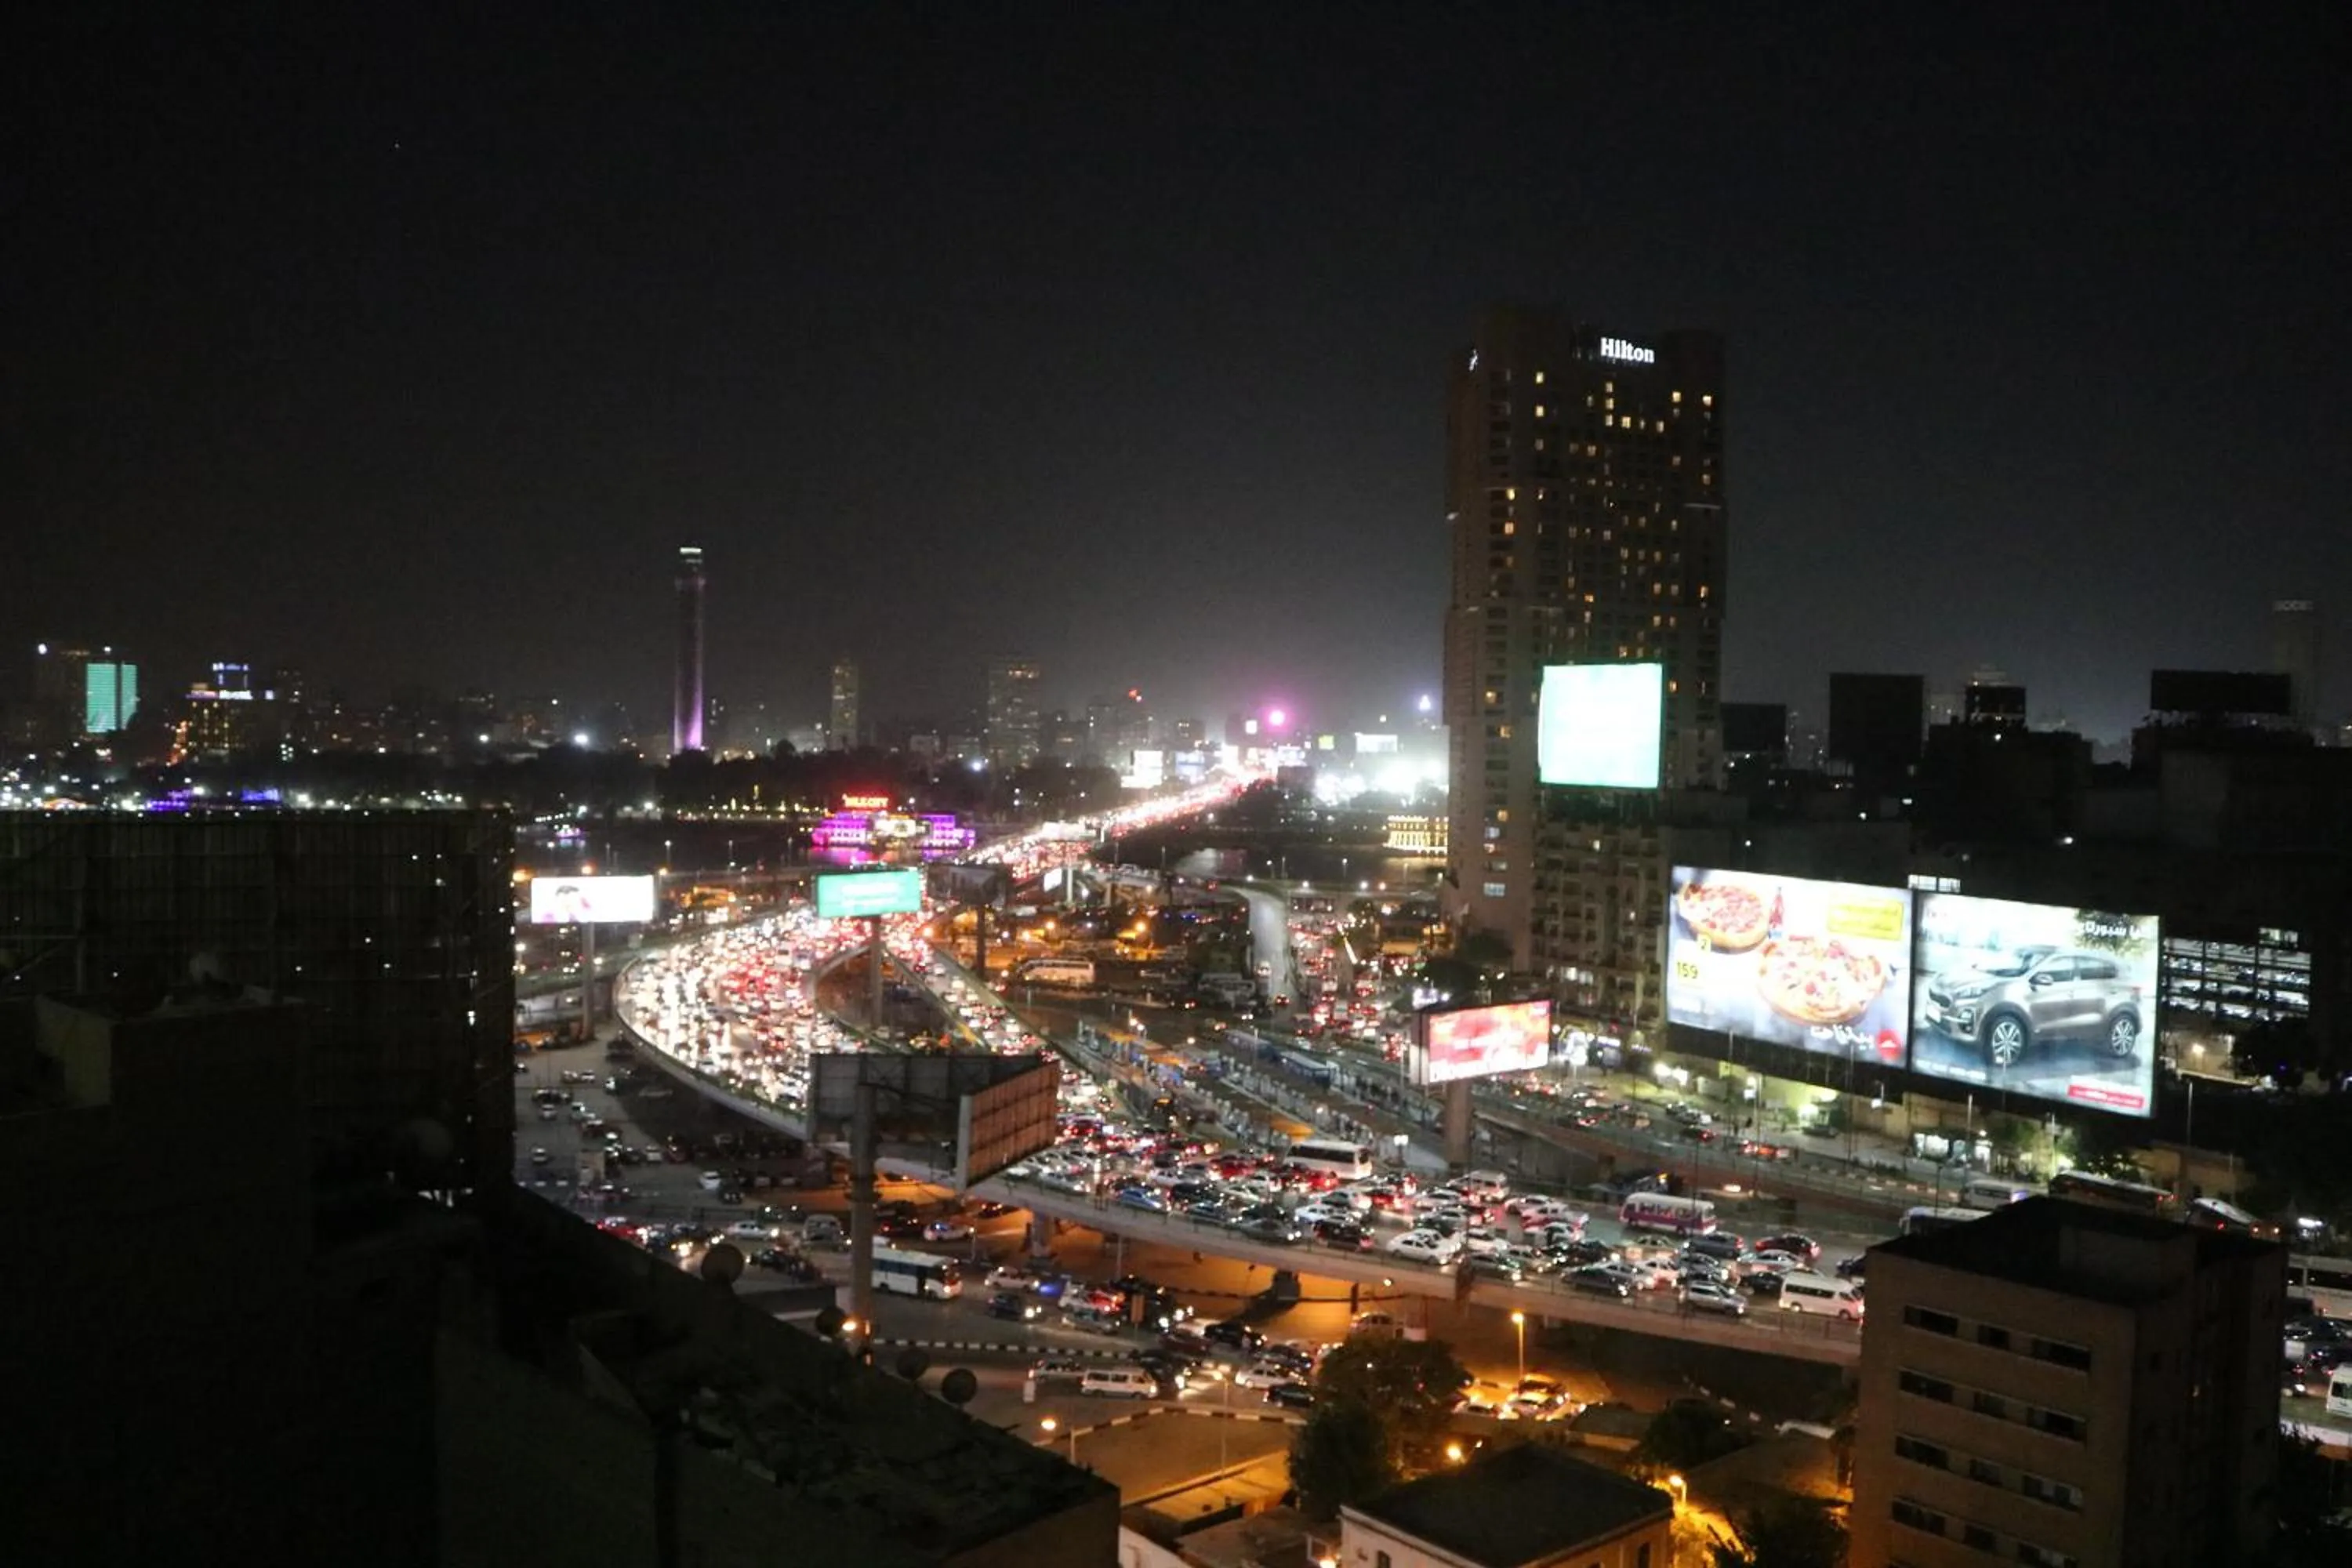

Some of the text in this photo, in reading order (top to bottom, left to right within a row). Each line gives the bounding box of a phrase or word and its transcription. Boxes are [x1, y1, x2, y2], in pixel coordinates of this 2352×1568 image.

[1600, 336, 1655, 364] Hilton
[1700, 938, 1708, 950] 2
[1676, 960, 1699, 979] 159
